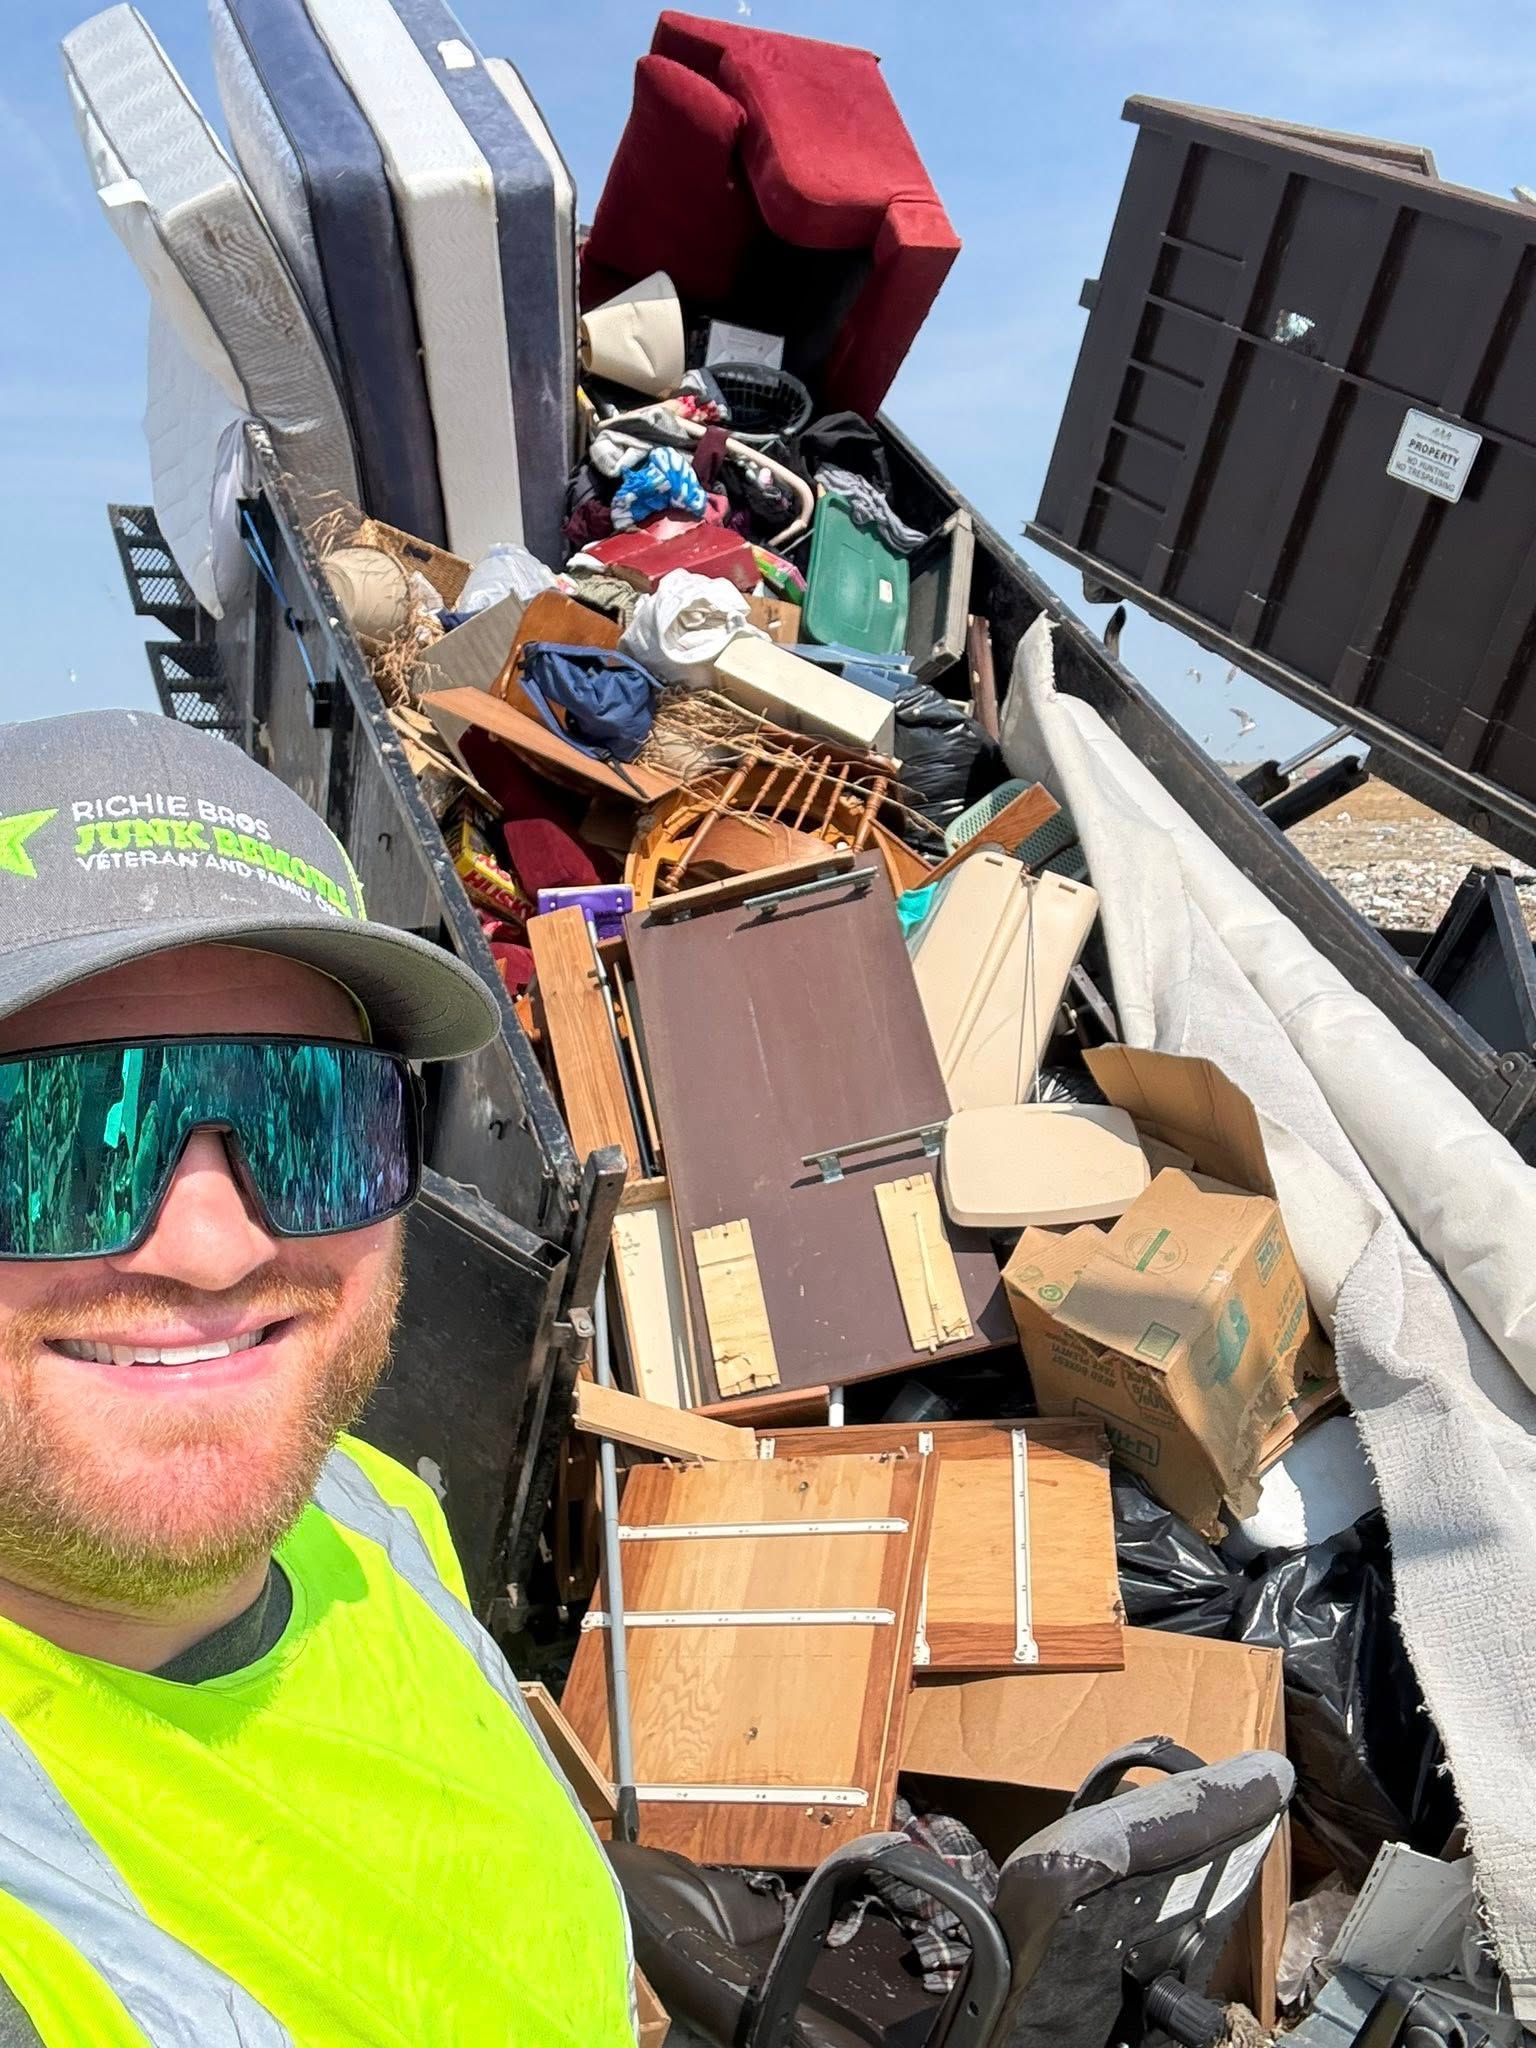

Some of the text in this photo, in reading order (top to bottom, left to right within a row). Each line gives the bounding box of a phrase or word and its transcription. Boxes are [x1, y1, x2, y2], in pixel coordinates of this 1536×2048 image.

[1407, 456, 1451, 480] NO HUNTING
[1408, 438, 1460, 467] PROPERTY
[1396, 461, 1456, 493] NO TRESPASSING
[71, 793, 272, 841] RICHIE BROS
[74, 818, 211, 855] JUNK
[75, 850, 199, 872] VETERAN
[205, 853, 252, 878] AND
[257, 867, 312, 903] FAMILY
